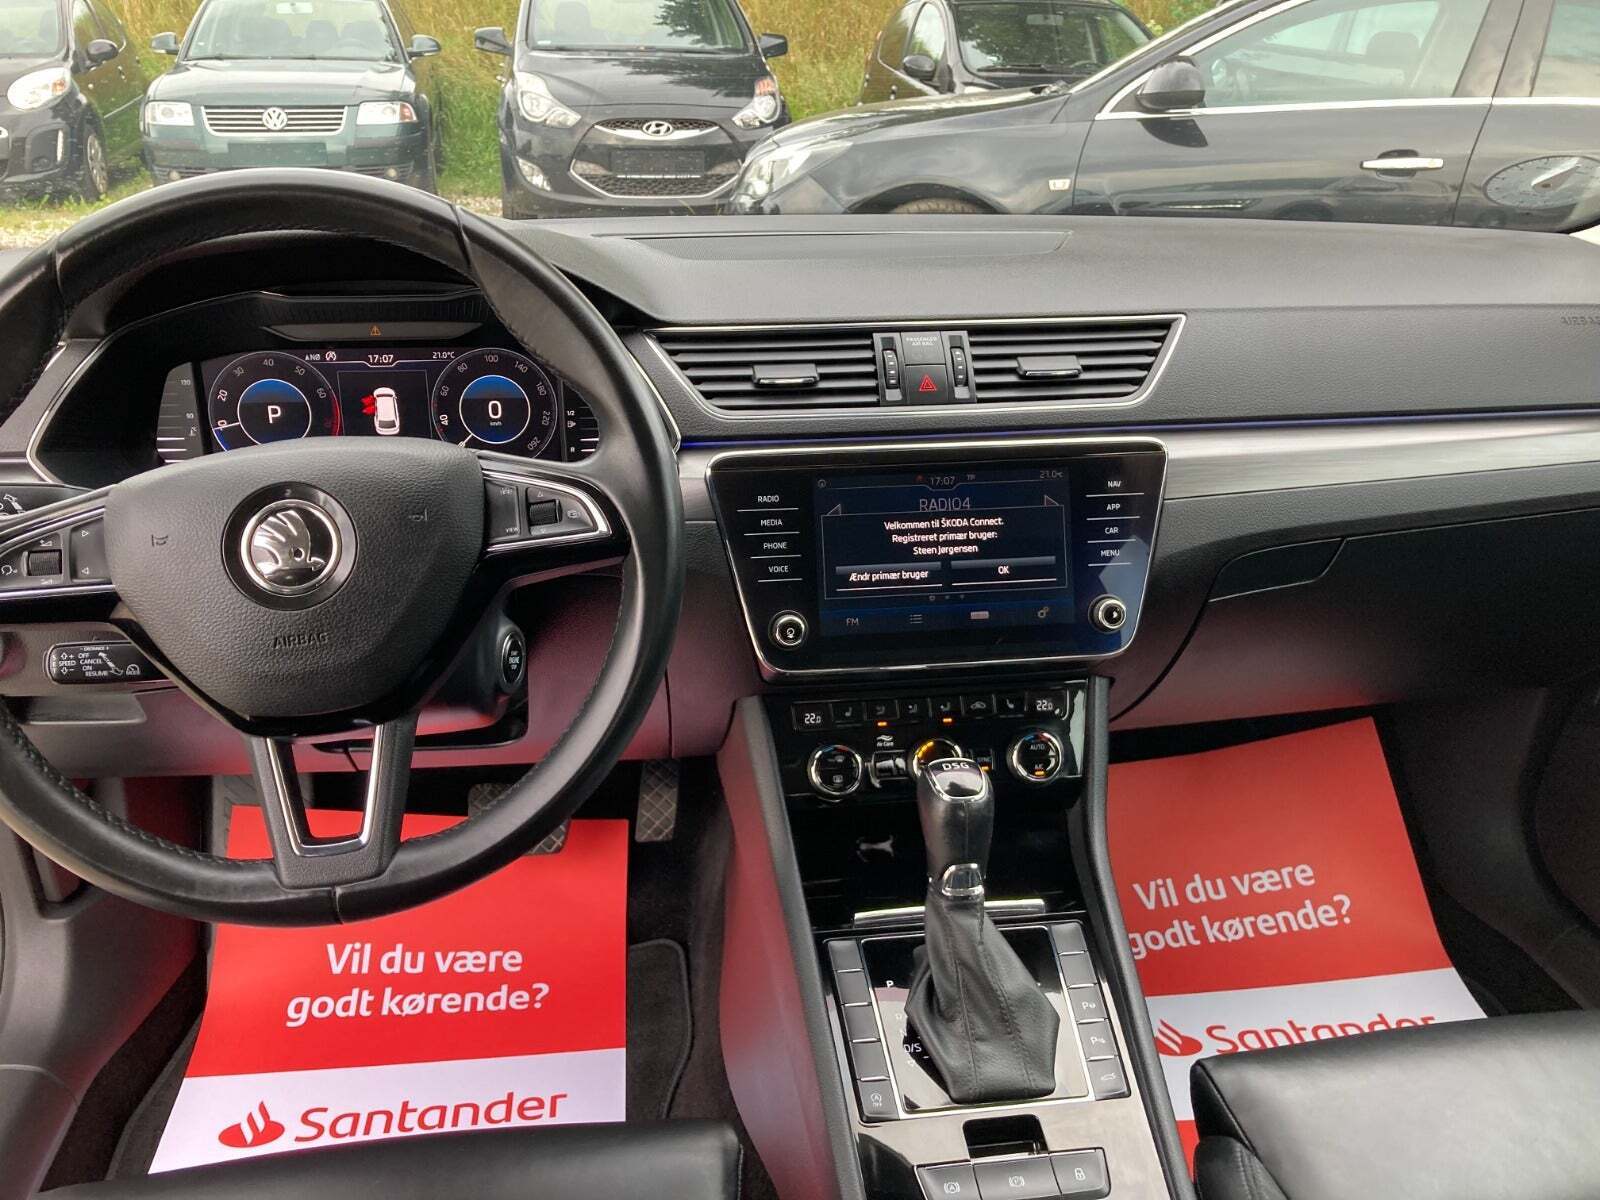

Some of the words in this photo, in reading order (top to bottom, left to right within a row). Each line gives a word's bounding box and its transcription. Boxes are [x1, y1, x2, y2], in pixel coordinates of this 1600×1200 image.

[263, 358, 274, 367] 40
[368, 354, 394, 363] 17:07
[484, 354, 499, 363] 100
[233, 366, 245, 377] 30
[294, 365, 306, 376] 50
[457, 362, 469, 374] 80
[514, 360, 529, 373] 140
[536, 382, 547, 396] 180
[216, 389, 228, 402] 20
[267, 405, 281, 424] P
[488, 400, 502, 419] 0
[439, 414, 449, 426] 40
[541, 410, 551, 426] 220
[527, 436, 541, 450] 260
[930, 476, 956, 486] 17:07
[1107, 480, 1122, 488] NAV
[757, 495, 780, 503] RADIO
[919, 497, 971, 512] RADIO4
[1106, 503, 1121, 511] APP
[760, 519, 783, 527] MEDIA
[884, 519, 930, 530] Velkommen
[931, 519, 940, 528] til
[940, 516, 969, 528] ŠKODA
[1104, 526, 1119, 534] CAR
[892, 533, 938, 544] Registreret
[939, 532, 967, 542] primær
[969, 530, 998, 541] bruger:
[763, 542, 788, 550] PHONE
[913, 546, 937, 555] Steen
[1100, 549, 1120, 557] MENU
[768, 565, 789, 573] VOICE
[997, 565, 1010, 574] OK
[849, 572, 871, 582] Ændr
[871, 571, 901, 581] primær
[901, 569, 929, 580] bruger
[846, 617, 859, 626] FM
[273, 632, 329, 649] AIRBAG
[942, 762, 970, 771] DSG
[1132, 876, 1179, 910] Vil
[1185, 873, 1227, 903] du
[1230, 863, 1316, 896] være
[1128, 922, 1201, 960] godt
[1201, 894, 1352, 943] kørende?
[326, 942, 369, 975] Vil
[380, 942, 424, 974] du
[435, 949, 523, 973] være
[886, 980, 894, 988] P
[285, 988, 375, 1027] godt
[381, 983, 549, 1016] kørende?
[294, 1091, 568, 1142] Santander
